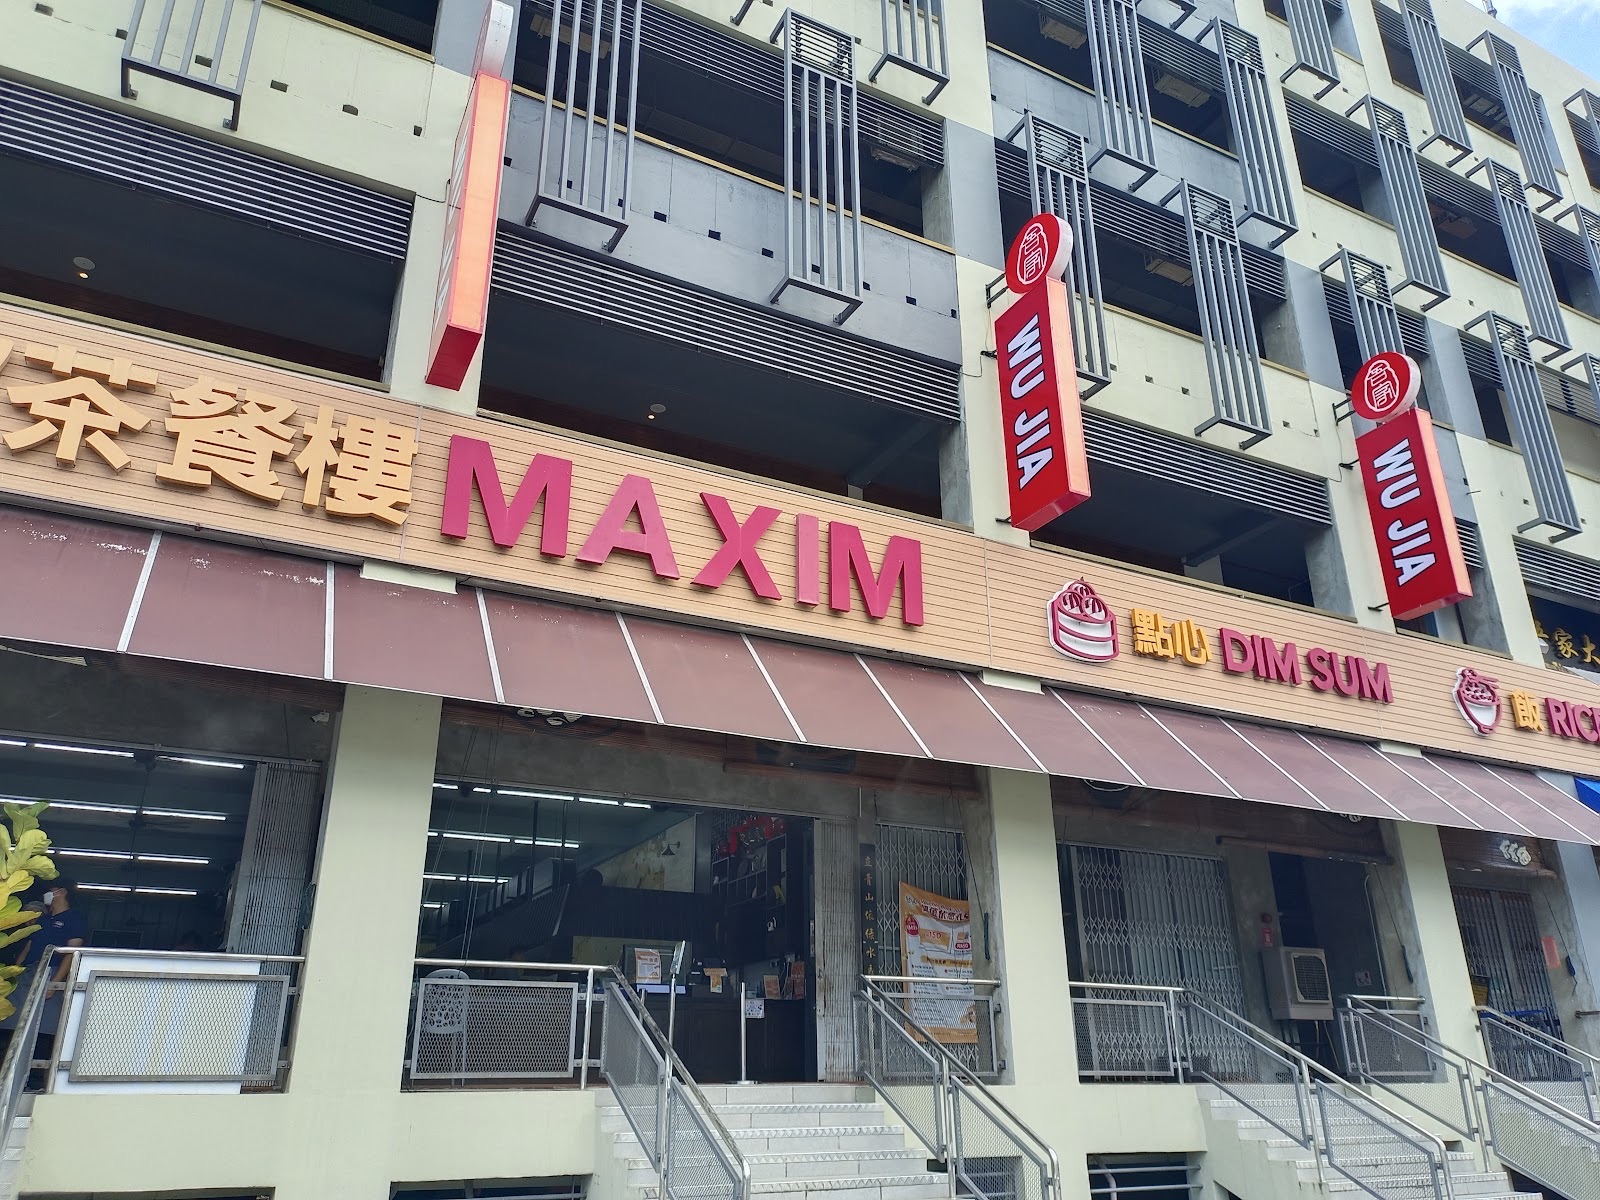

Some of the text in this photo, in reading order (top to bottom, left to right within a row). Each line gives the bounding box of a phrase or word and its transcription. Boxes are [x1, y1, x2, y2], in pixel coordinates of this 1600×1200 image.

[0, 339, 418, 526] 茶餐樓
[1007, 314, 1053, 491] WU JIA
[441, 434, 924, 627] MAXIM
[1373, 438, 1436, 586] WU JIA
[1131, 608, 1212, 666] 點心
[1220, 627, 1394, 704] DIM SUM
[1509, 689, 1545, 732] 飯
